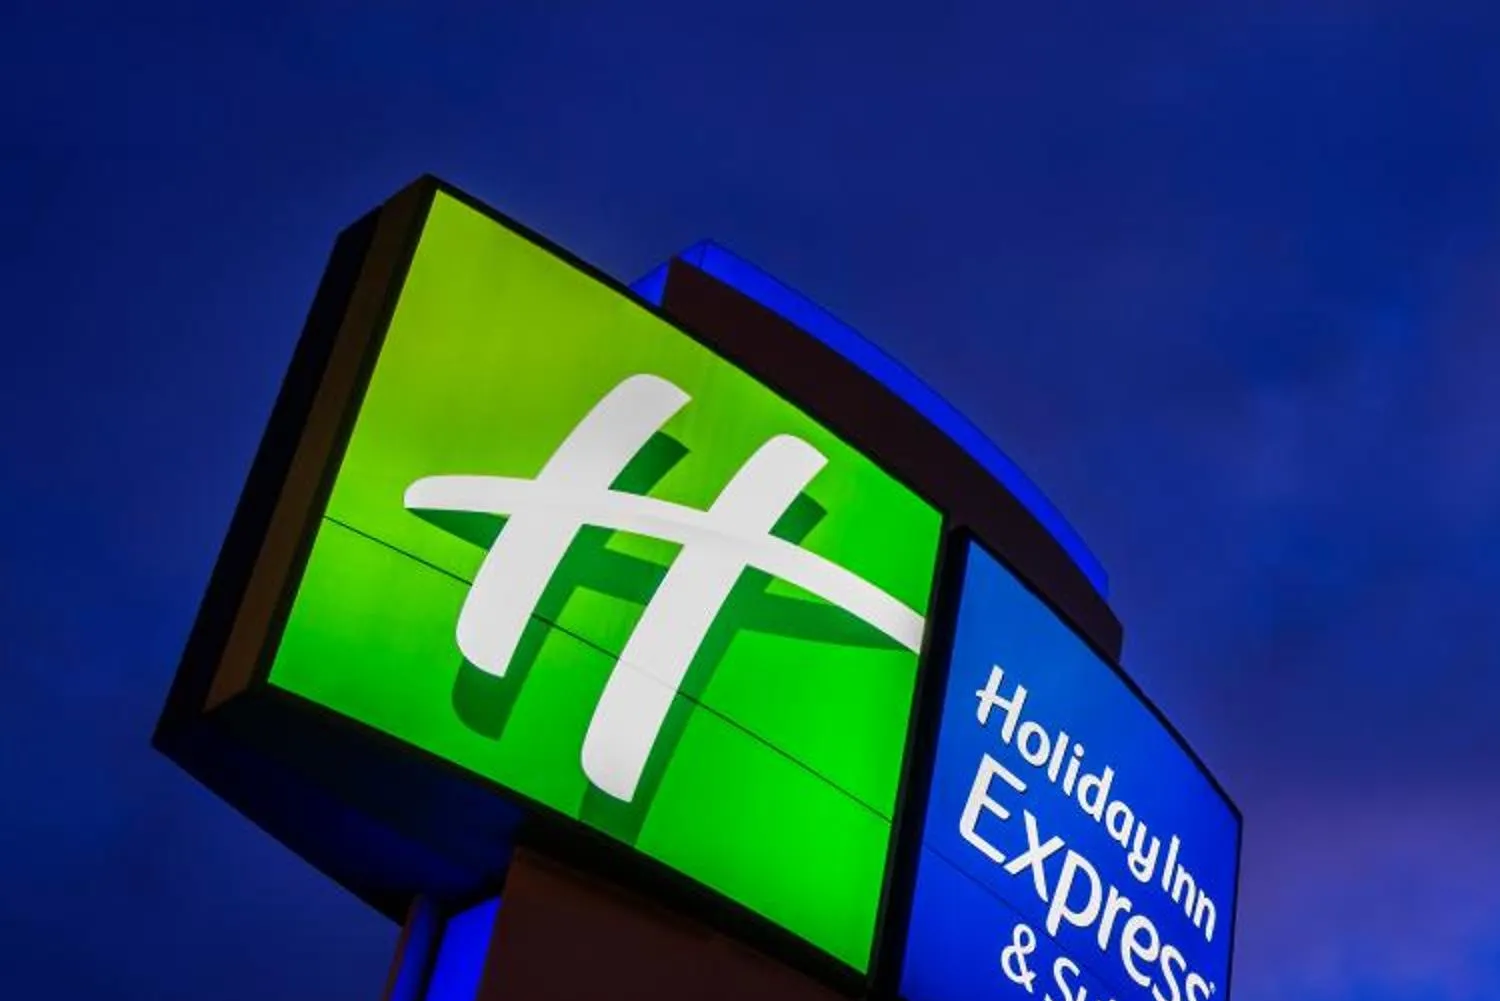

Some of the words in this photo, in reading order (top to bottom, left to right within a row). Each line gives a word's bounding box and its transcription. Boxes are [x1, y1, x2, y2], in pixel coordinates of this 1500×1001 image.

[975, 664, 1161, 882] Holiday
[1162, 834, 1216, 942] Inn
[1000, 924, 1036, 993] &
